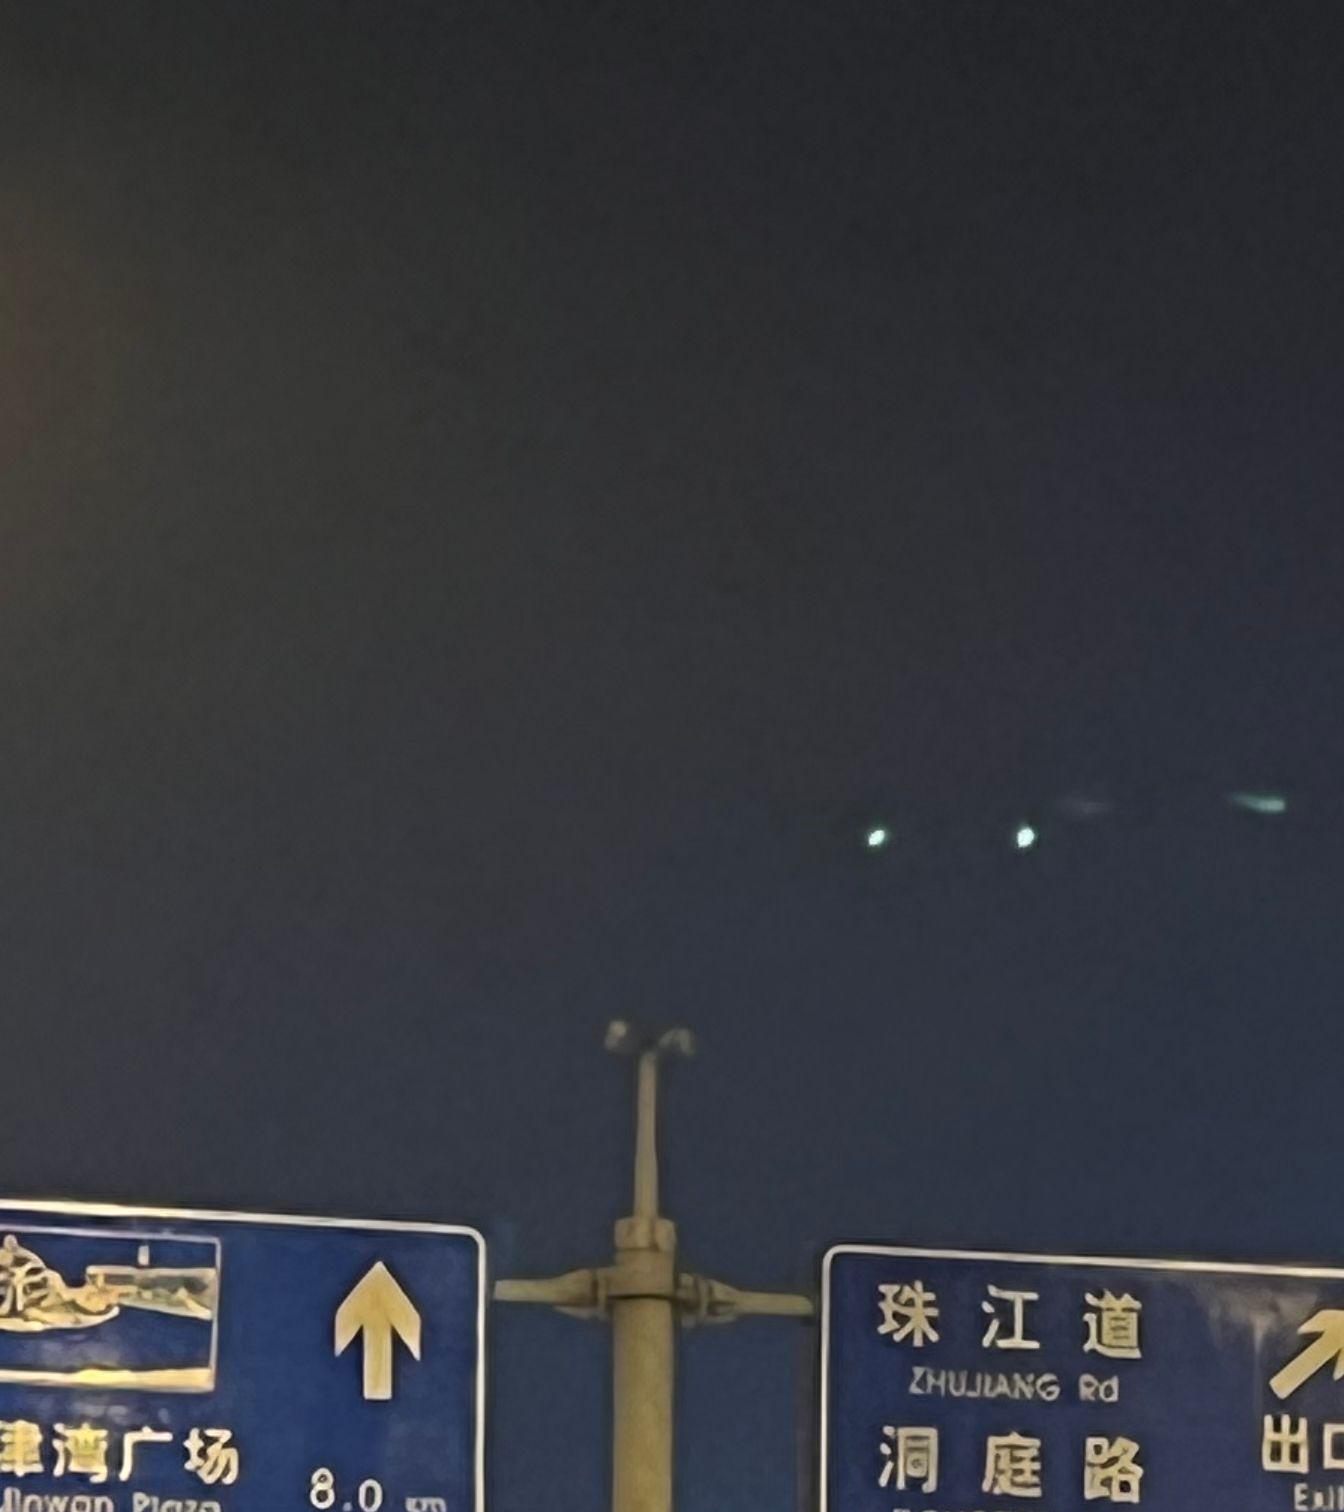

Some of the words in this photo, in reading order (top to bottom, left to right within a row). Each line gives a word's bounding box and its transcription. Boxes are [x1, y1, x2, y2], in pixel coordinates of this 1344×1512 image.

[876, 1279, 1143, 1359] 珠江道
[908, 1366, 1061, 1401] ZHUJIANG
[1078, 1373, 1119, 1402] Rd
[877, 1424, 1145, 1504] 洞庭路
